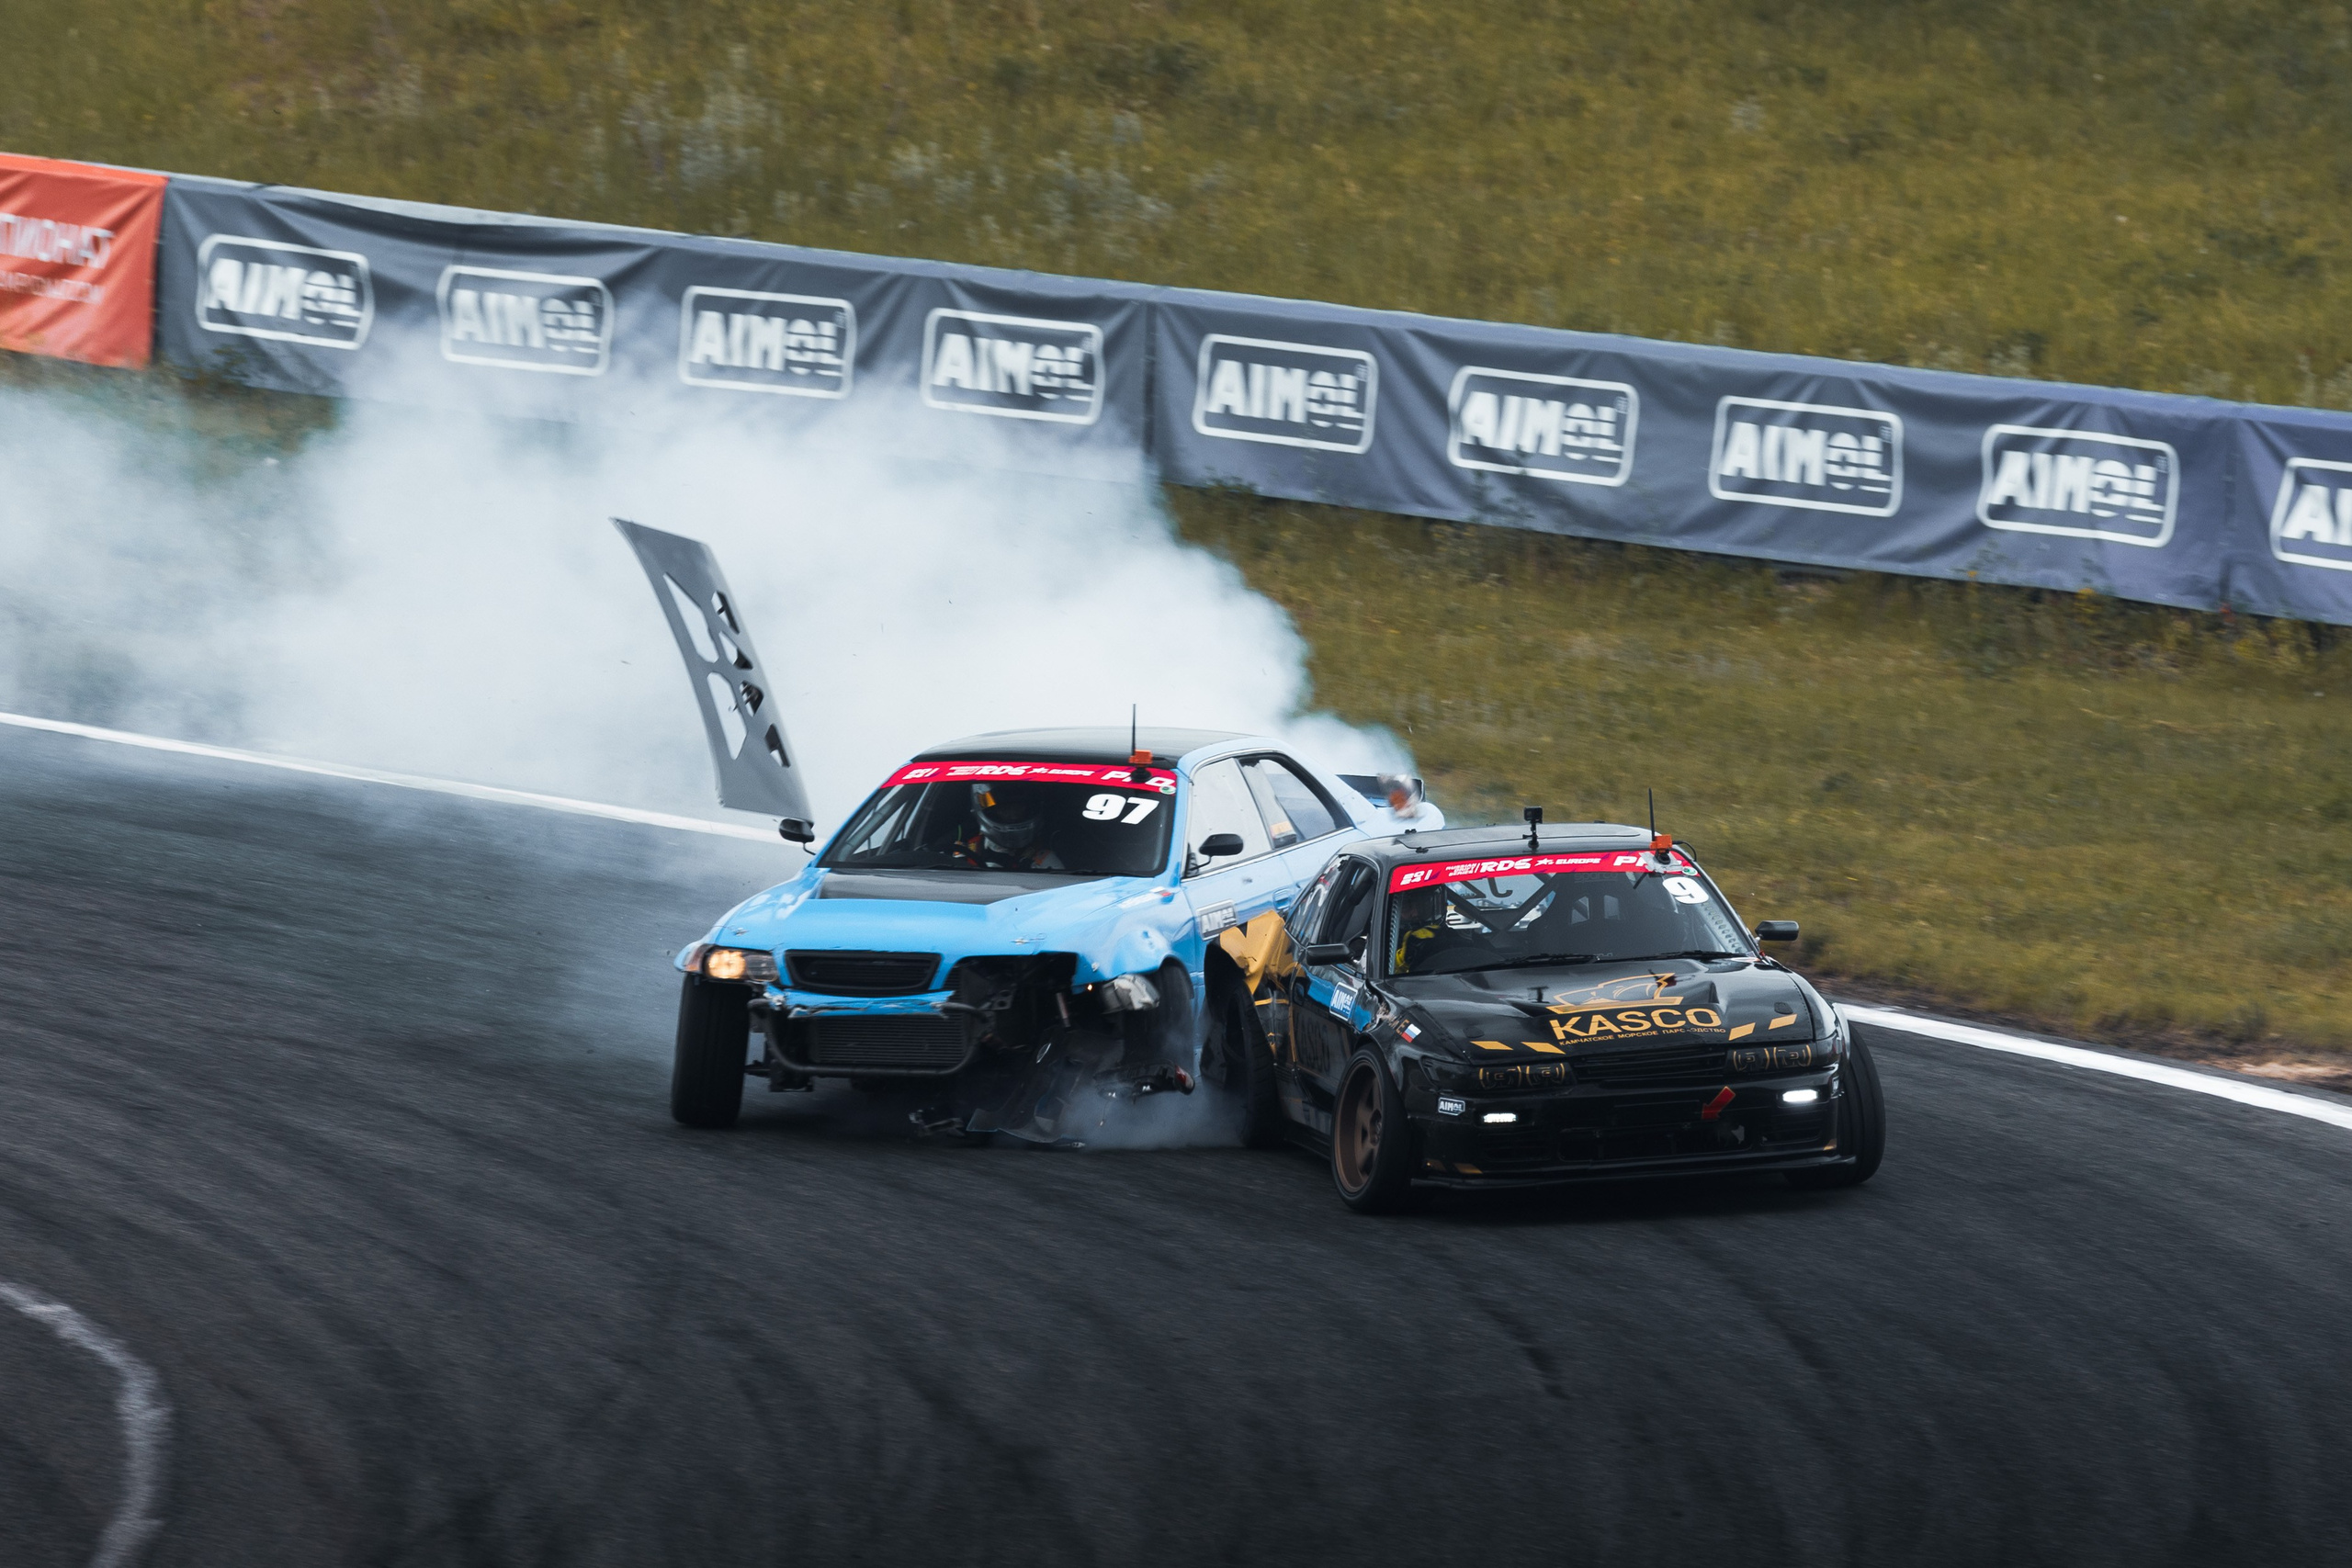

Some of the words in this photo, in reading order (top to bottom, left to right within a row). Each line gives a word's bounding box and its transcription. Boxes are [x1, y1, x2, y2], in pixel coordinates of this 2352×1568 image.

[205, 258, 362, 328] AIMOL
[450, 288, 602, 354] AIMOL
[687, 310, 844, 377] AIMOL
[931, 333, 1093, 401] AIMOL
[1206, 359, 1363, 430] AIMOL
[1461, 391, 1622, 462] AIMOL
[1721, 422, 1892, 493] AIMOL
[1989, 451, 2162, 524] AIMOL
[1082, 794, 1159, 825] 97
[1101, 771, 1175, 787] PO
[1480, 858, 1532, 873] RDS
[1555, 857, 1601, 865] EUROPE
[1663, 877, 1709, 904] 9
[1549, 1008, 1722, 1041] KASCO
[1559, 1034, 1614, 1046] КАМЧАТСКОЕ
[1618, 1031, 1659, 1040] МОРСКОЕ
